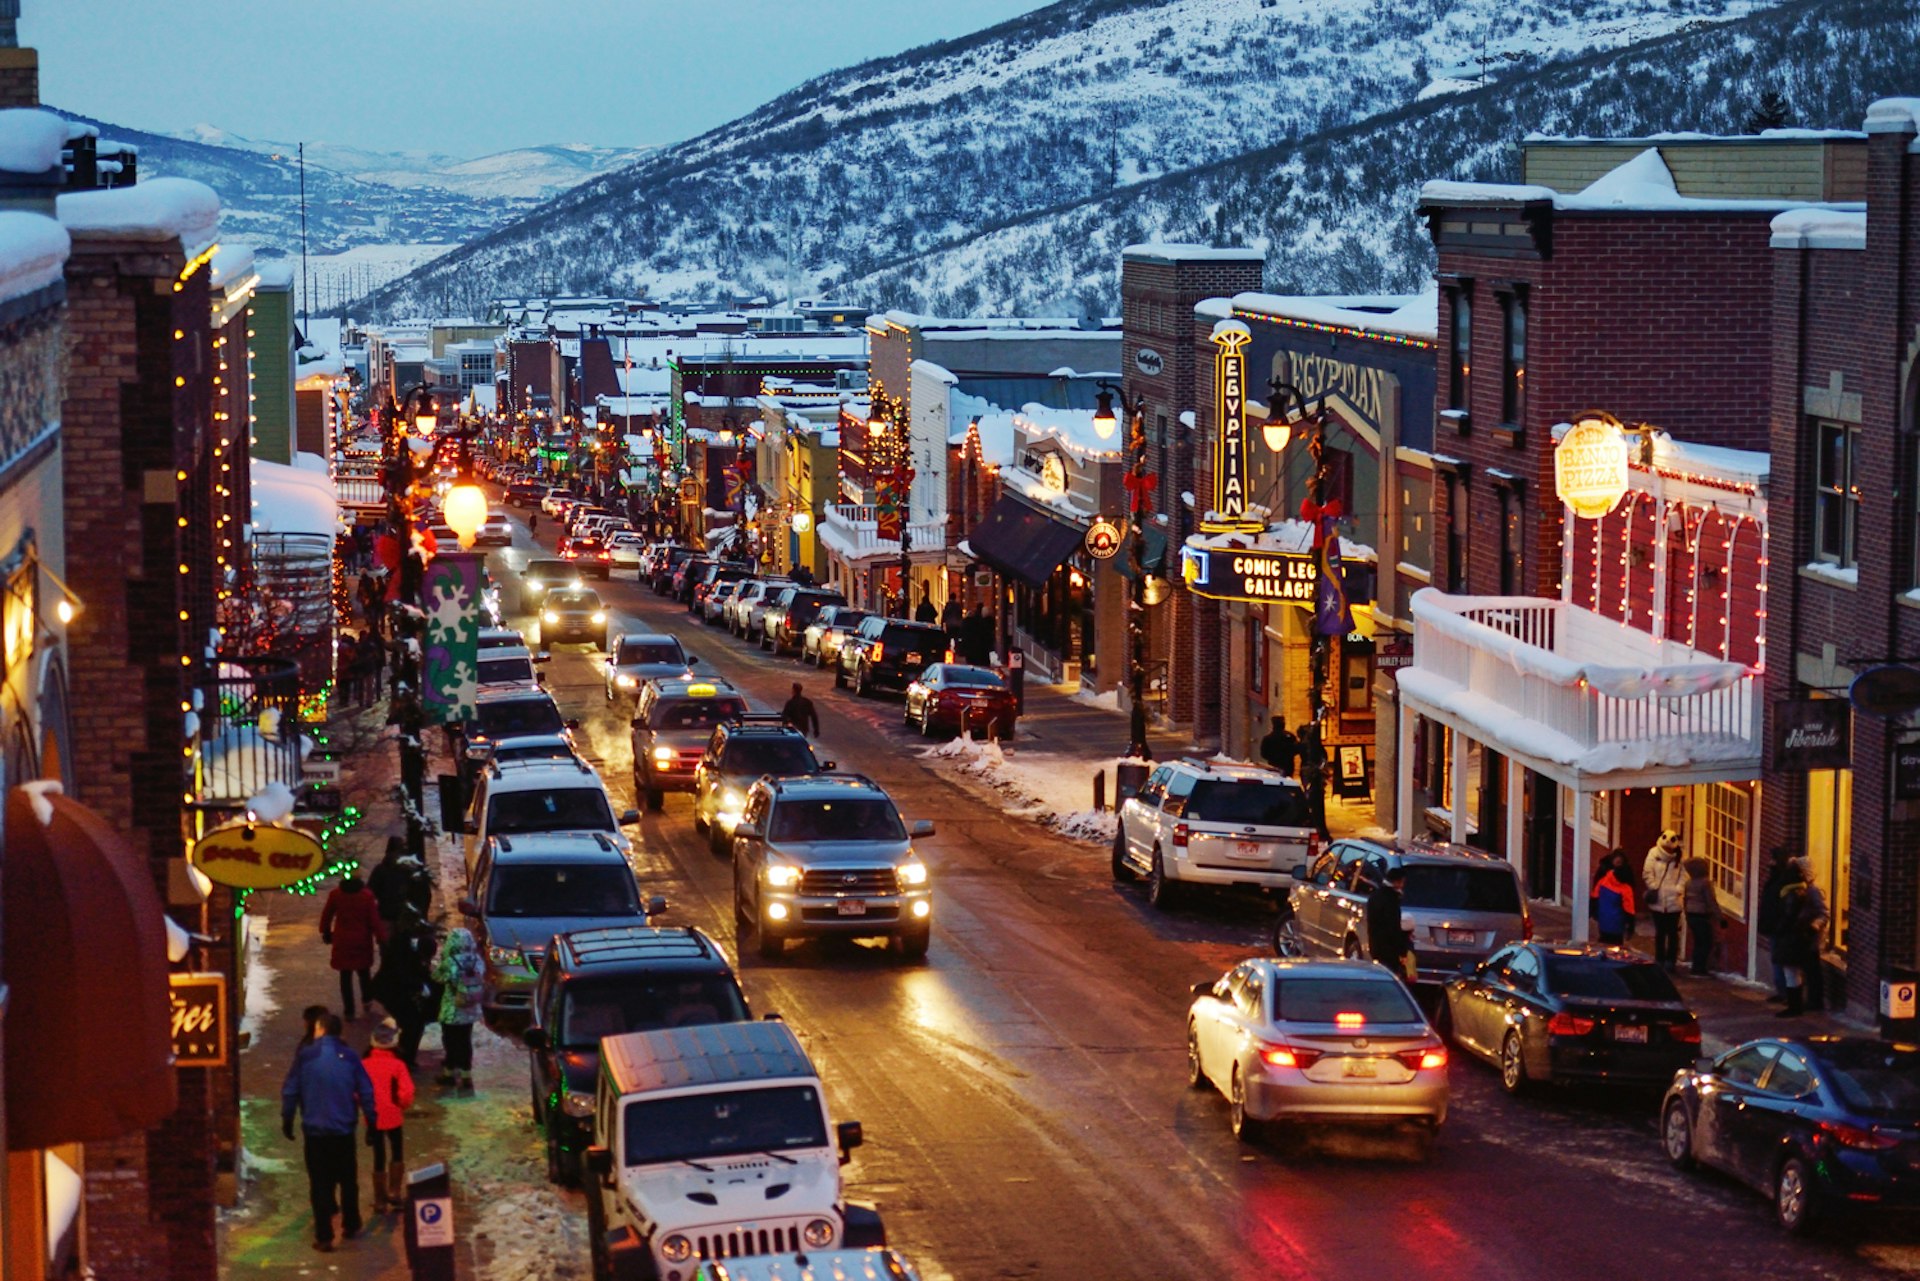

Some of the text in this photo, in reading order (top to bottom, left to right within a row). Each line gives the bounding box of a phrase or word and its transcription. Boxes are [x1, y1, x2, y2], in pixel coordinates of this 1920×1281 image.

[1286, 350, 1385, 425] EGYPTIAN
[1225, 359, 1242, 515] EGYPTIAN
[1575, 428, 1605, 446] RED
[1563, 446, 1620, 467] BANJO
[1564, 467, 1620, 488] PIZZA
[1233, 557, 1281, 576] COMIC
